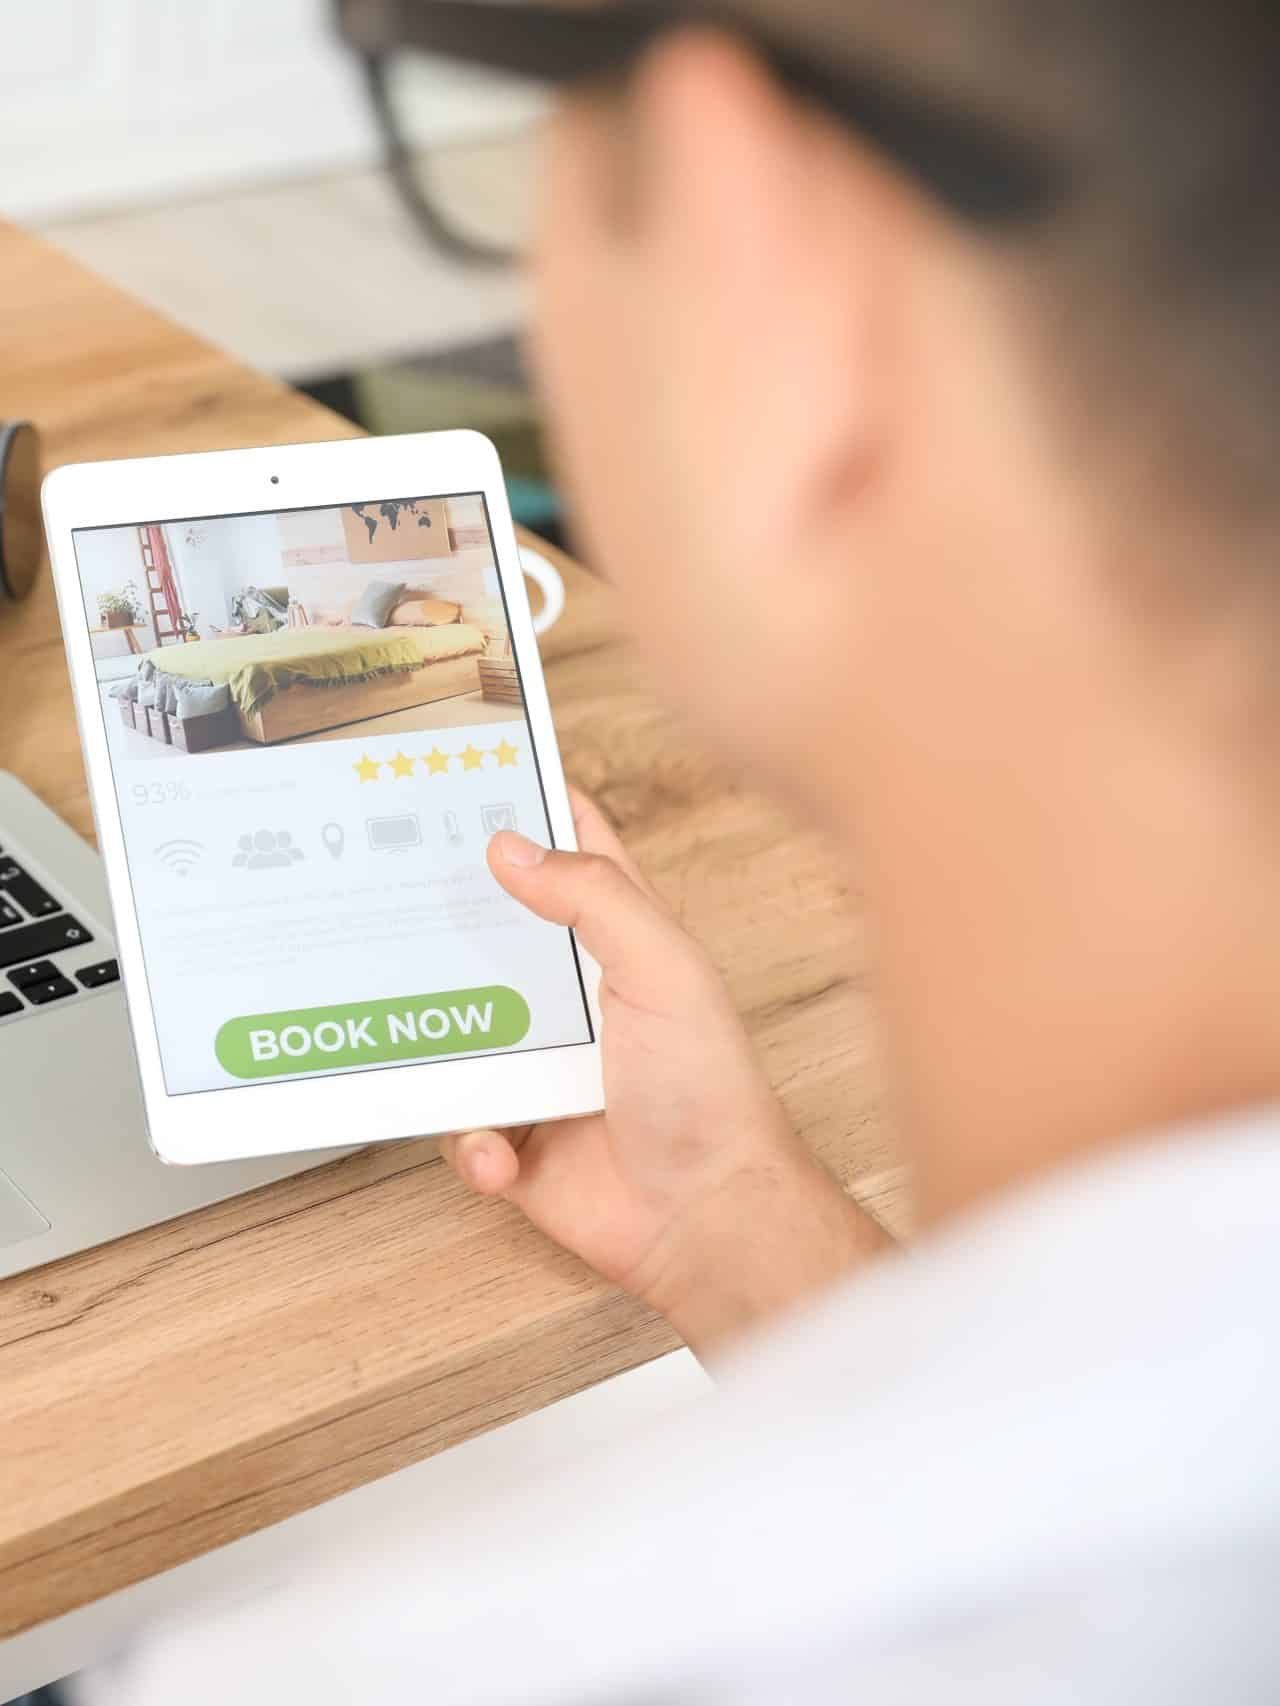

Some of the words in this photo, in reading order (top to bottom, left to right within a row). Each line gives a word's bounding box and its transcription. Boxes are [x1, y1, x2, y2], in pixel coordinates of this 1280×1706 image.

[131, 776, 192, 808] 93%
[249, 1016, 377, 1062] BOOK
[387, 1002, 494, 1044] NOW
